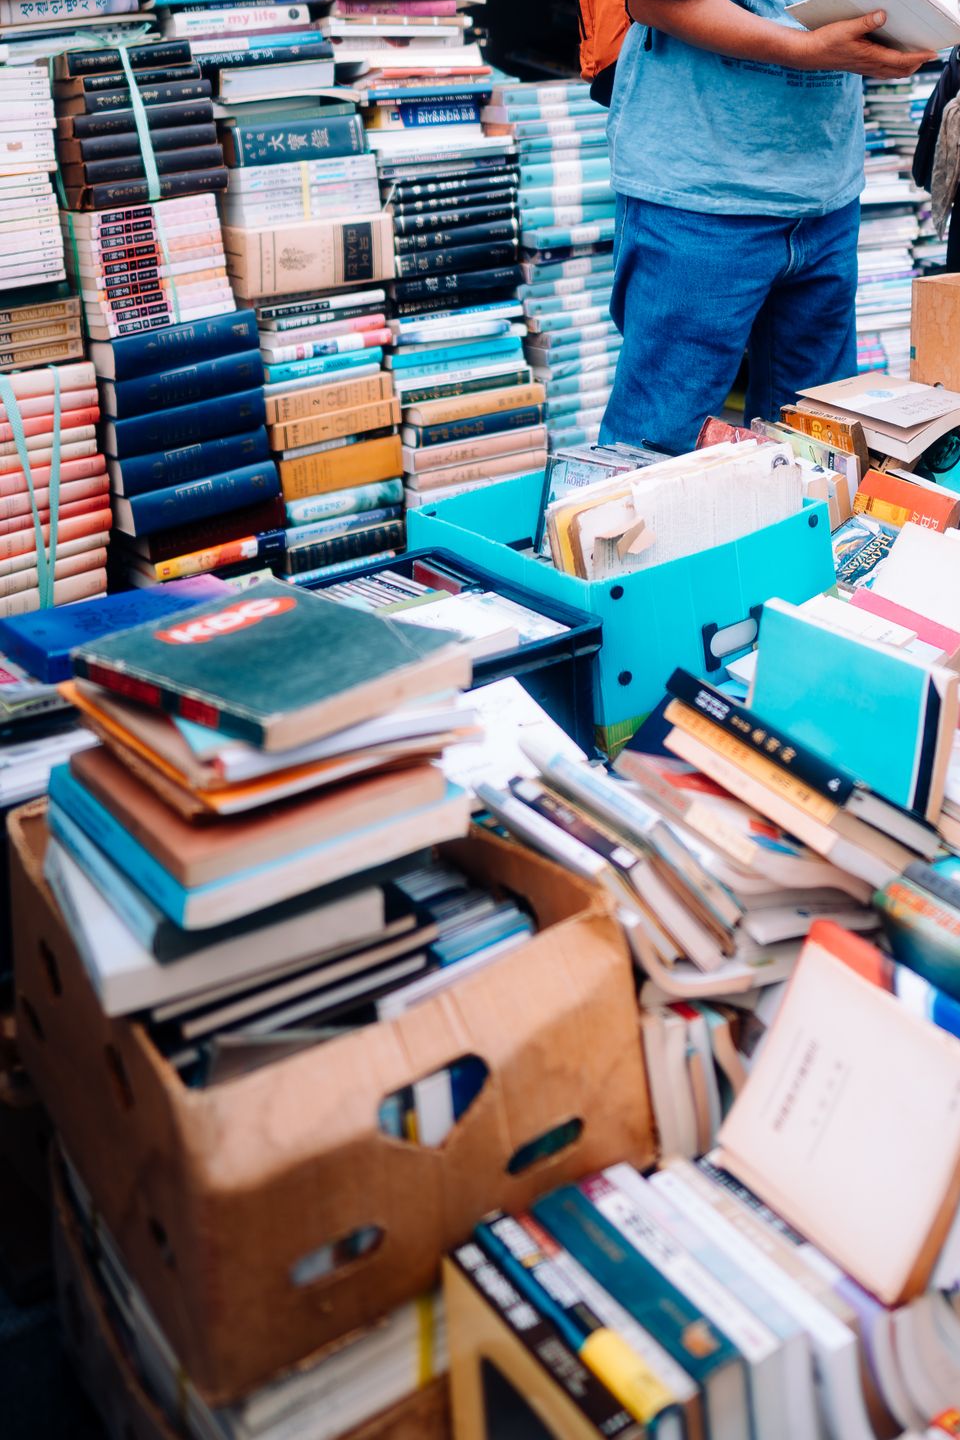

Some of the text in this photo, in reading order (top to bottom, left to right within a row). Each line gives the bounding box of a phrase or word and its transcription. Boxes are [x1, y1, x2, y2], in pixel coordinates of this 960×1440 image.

[227, 10, 278, 26] my life
[842, 533, 894, 577] HORIZON
[860, 543, 892, 571] LOST
